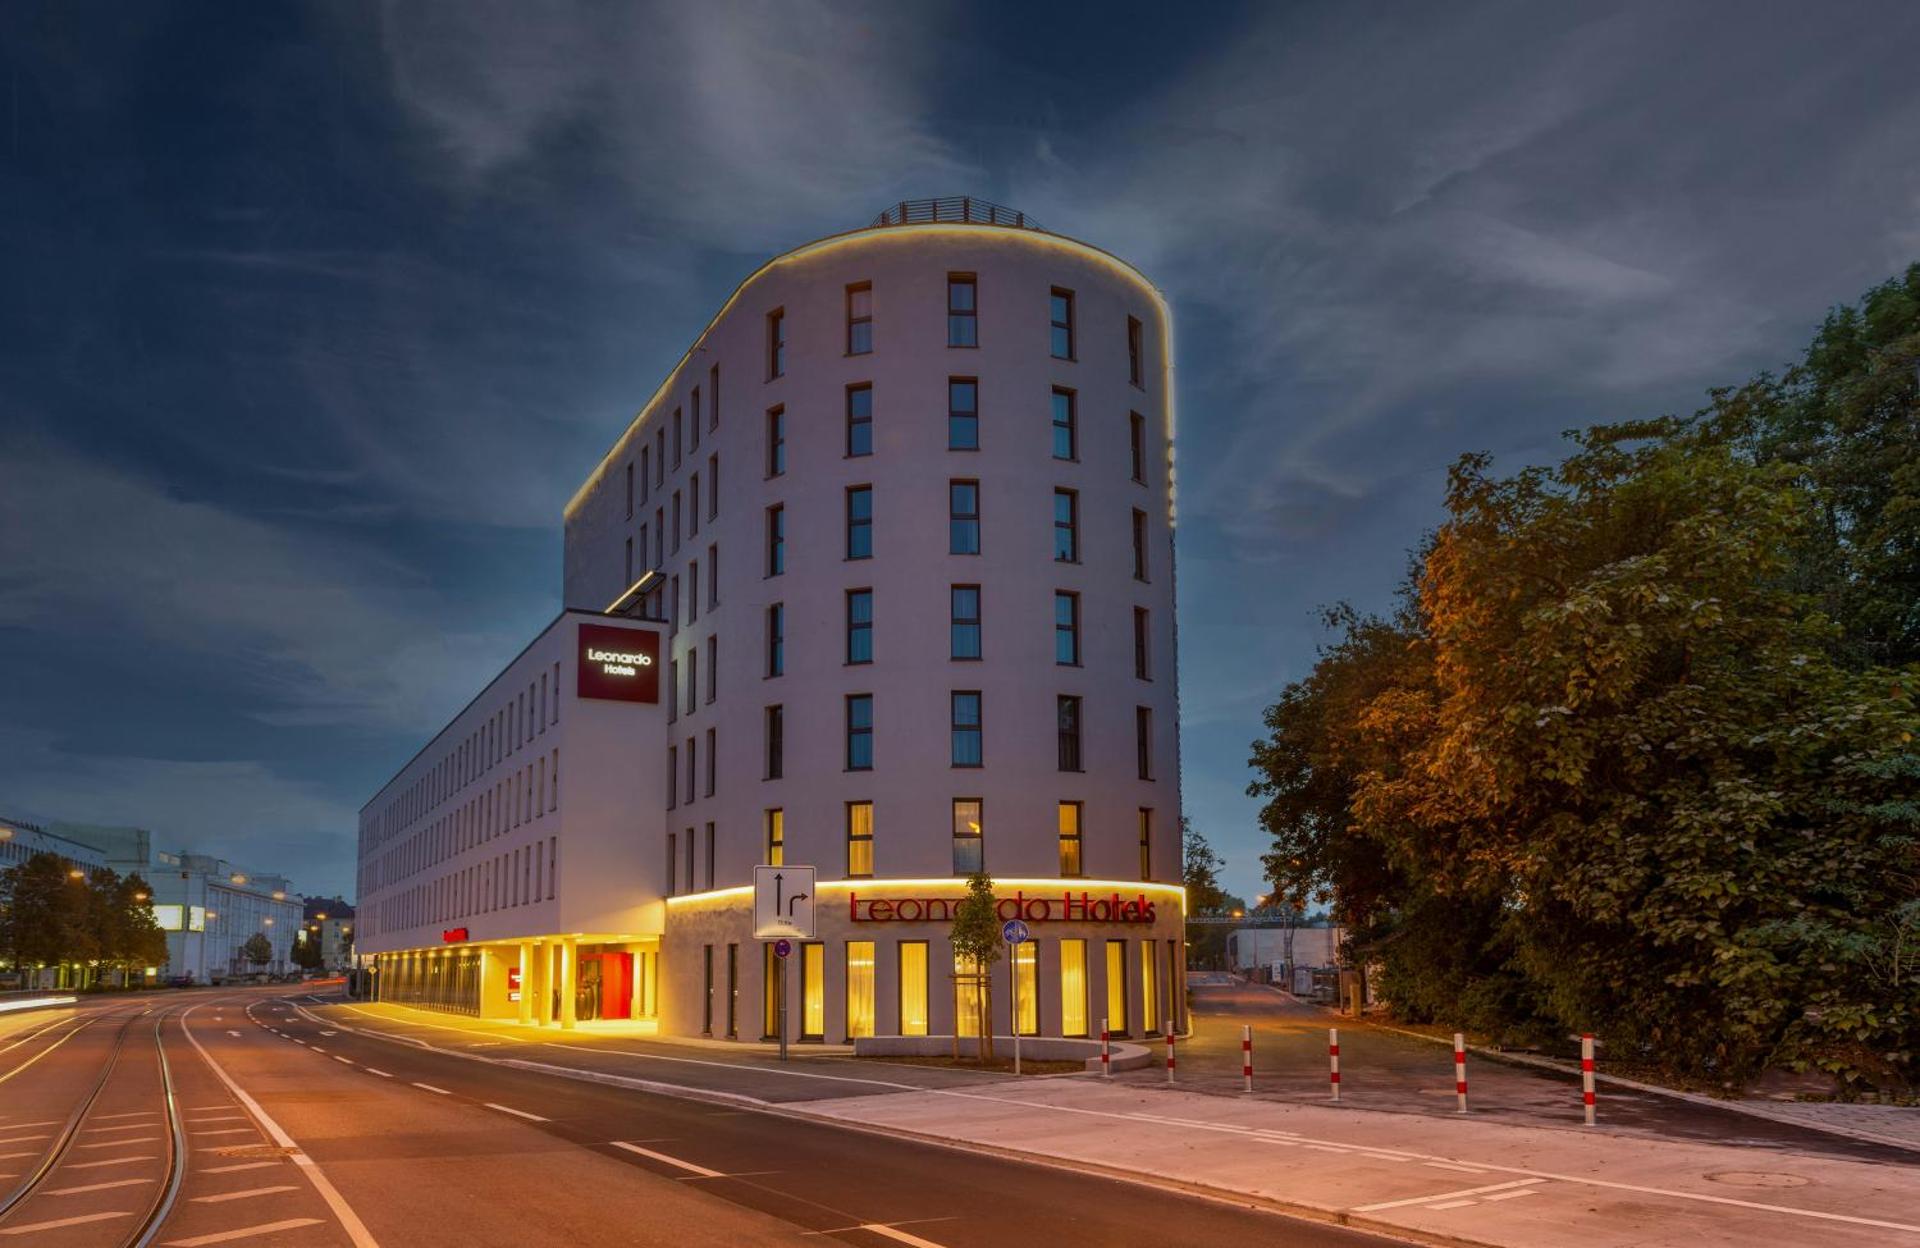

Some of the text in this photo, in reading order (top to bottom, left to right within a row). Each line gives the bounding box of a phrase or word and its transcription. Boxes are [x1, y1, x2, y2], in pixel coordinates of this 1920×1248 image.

[588, 648, 651, 666] Leonardo
[604, 664, 636, 676] Hotels
[850, 891, 1155, 923] Leondo Hotels
